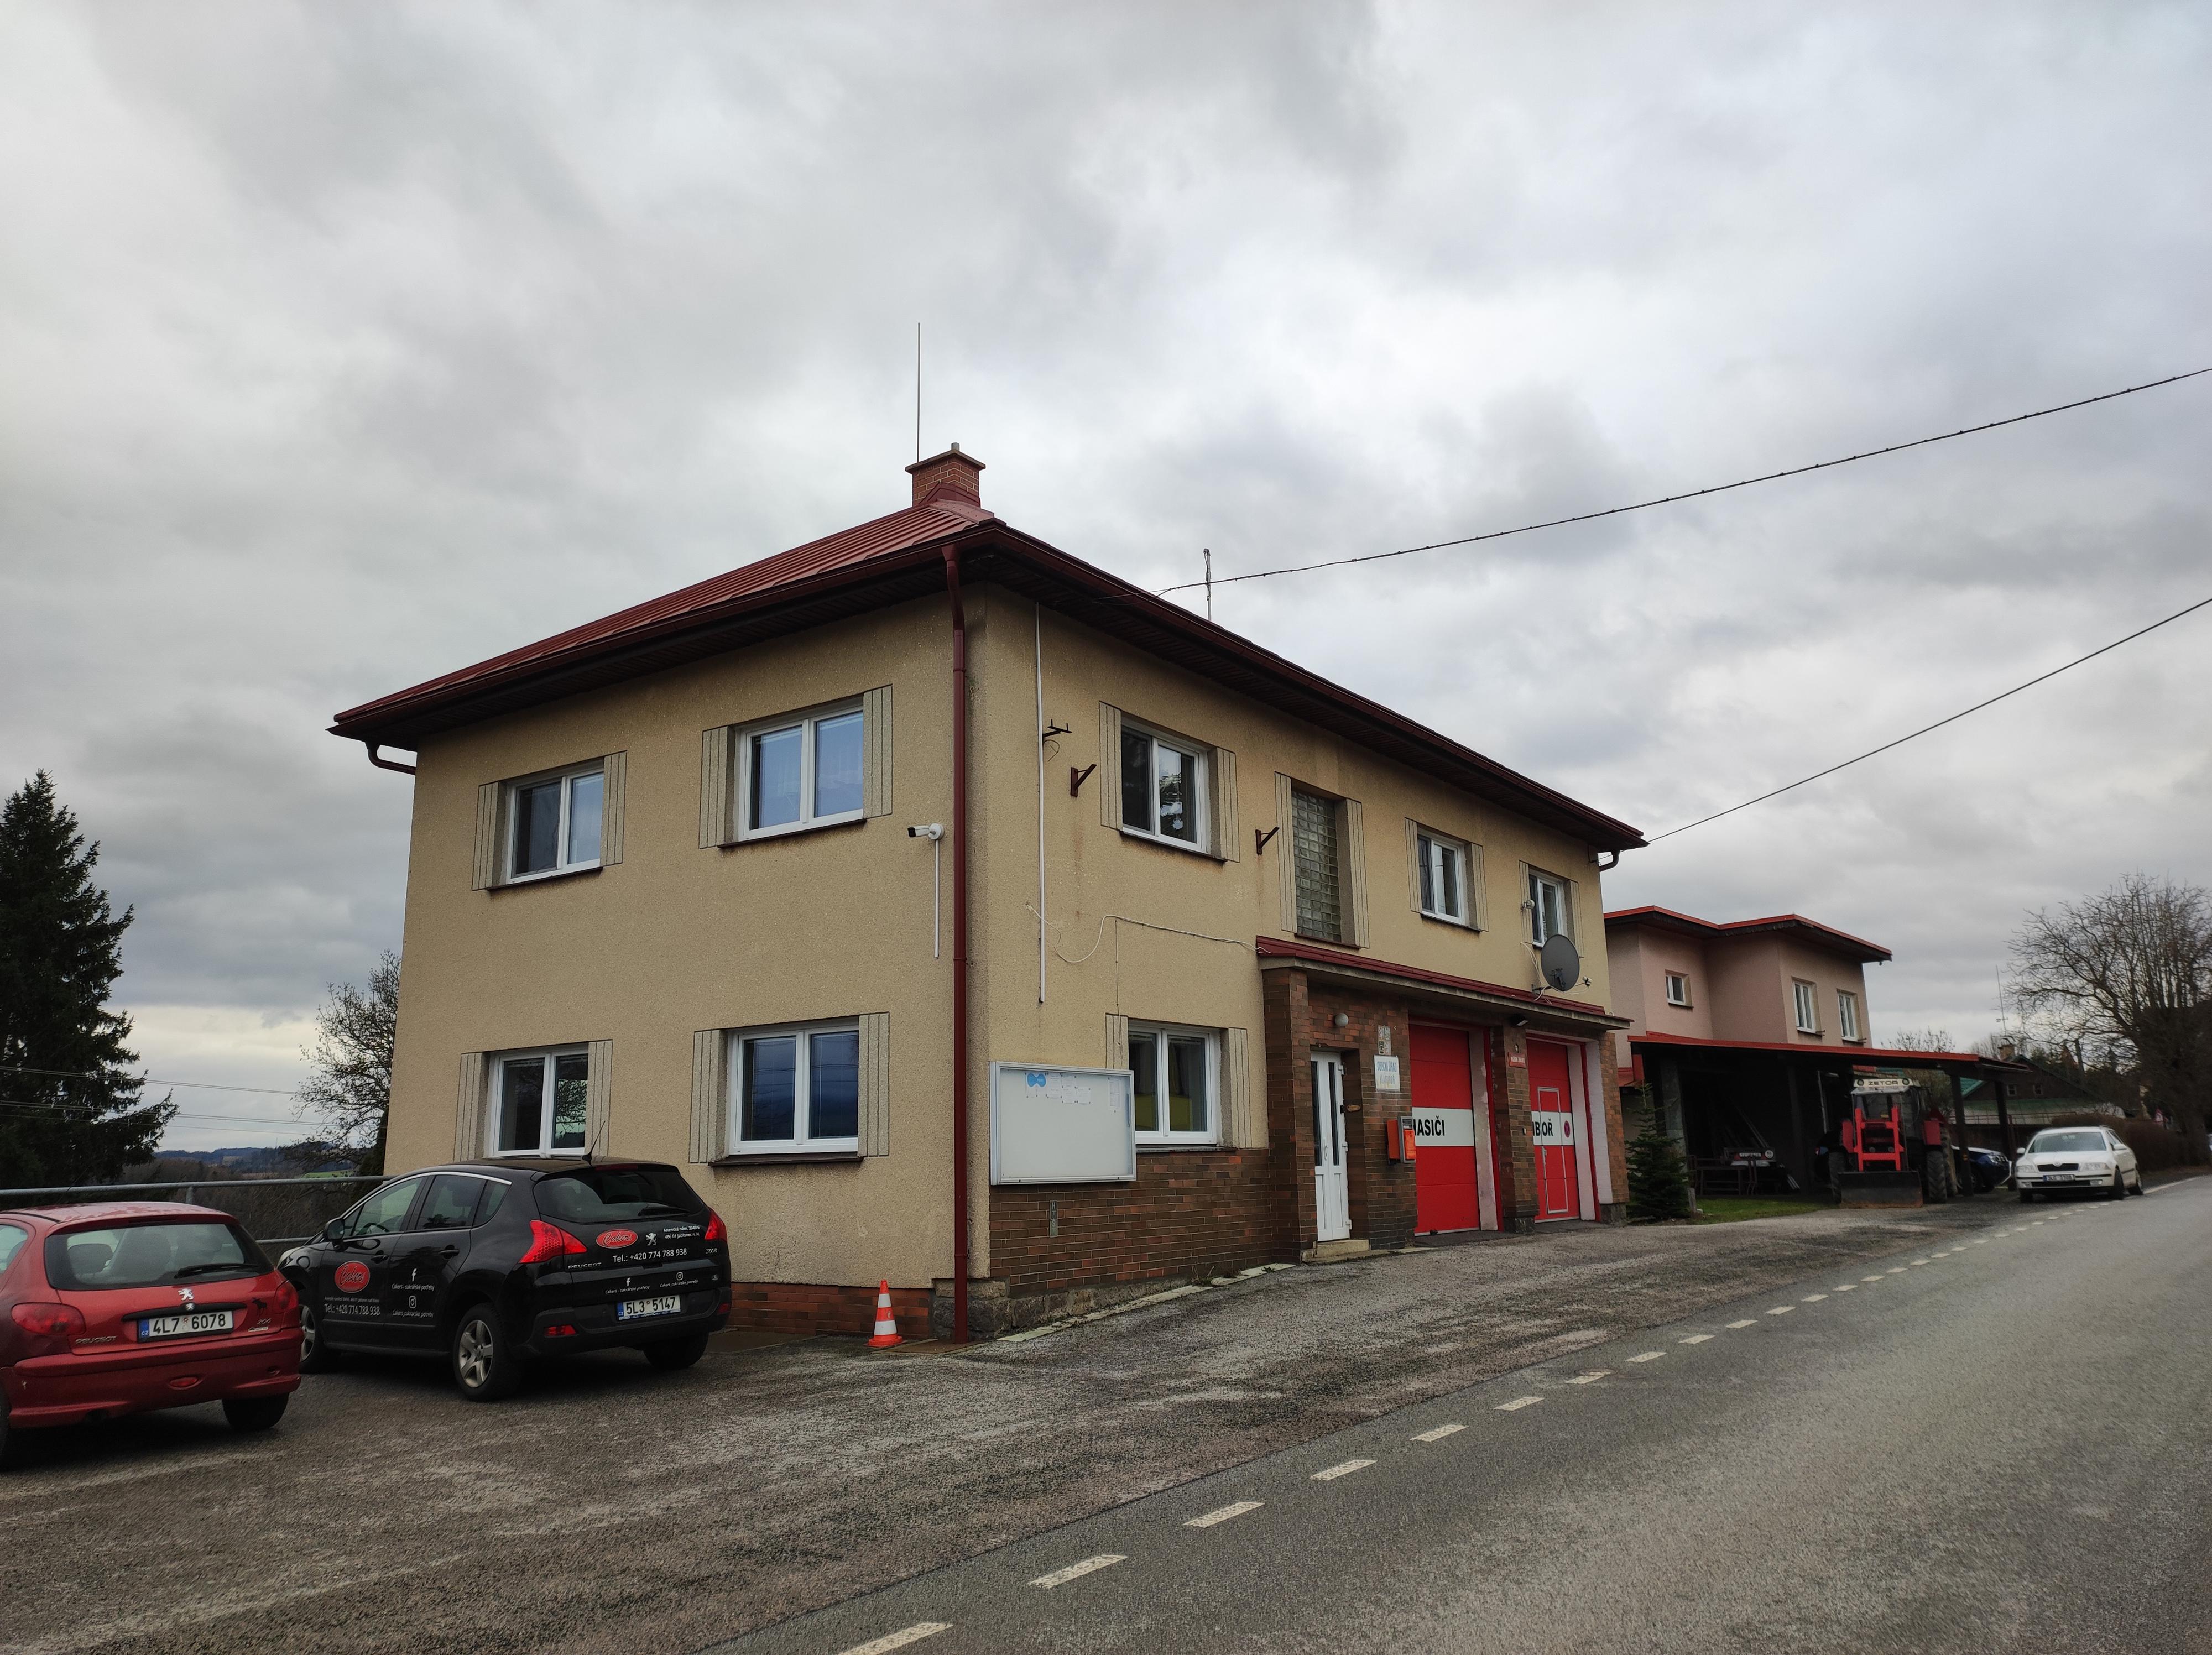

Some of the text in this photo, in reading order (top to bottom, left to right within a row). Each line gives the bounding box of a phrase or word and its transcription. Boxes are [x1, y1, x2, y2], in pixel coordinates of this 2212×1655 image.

[603, 1233, 632, 1244] Cakers
[613, 1248, 687, 1264] Tel.: +420 774 788 938
[336, 1304, 348, 1314] +420
[348, 1304, 358, 1314] 774
[358, 1305, 369, 1315] 788
[369, 1306, 380, 1316] 938
[626, 1301, 645, 1315] 5L3
[652, 1297, 676, 1311] 5147
[153, 1318, 180, 1333] 4L7
[191, 1313, 226, 1329] 6078
[75, 1335, 117, 1345] PEUGEOT
